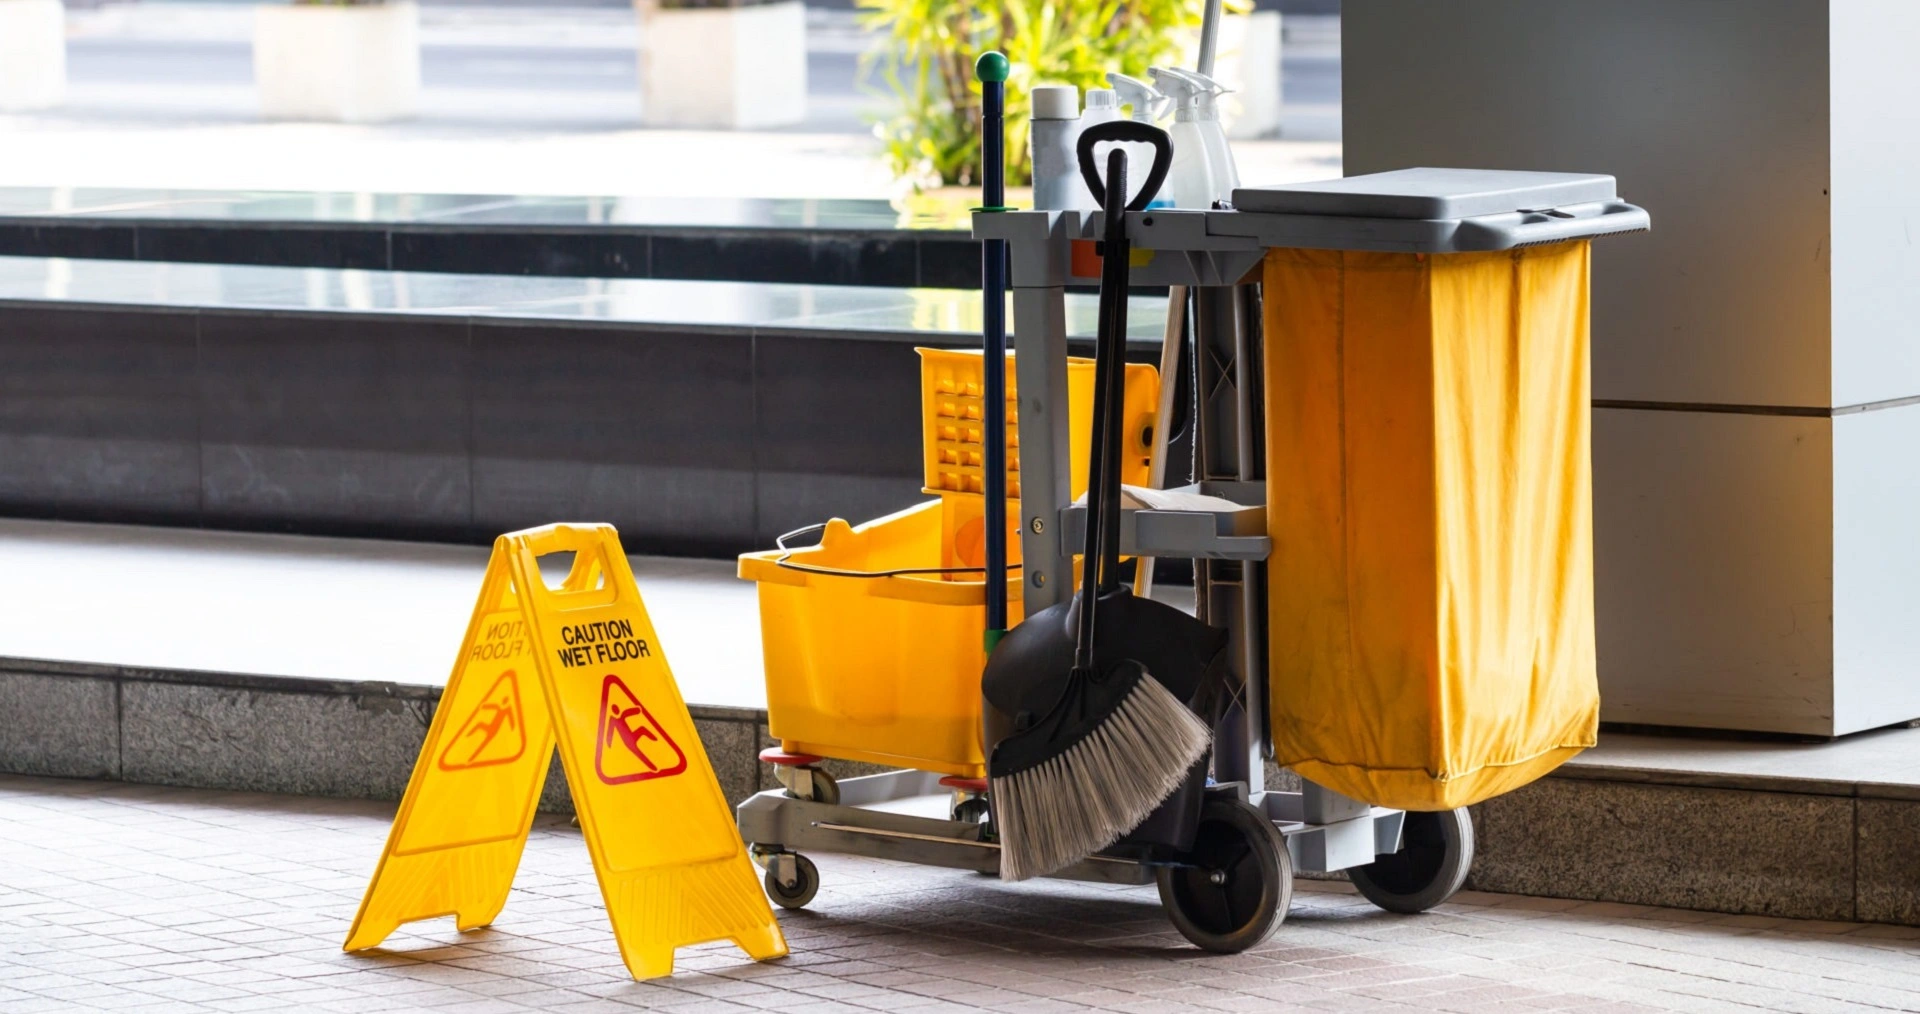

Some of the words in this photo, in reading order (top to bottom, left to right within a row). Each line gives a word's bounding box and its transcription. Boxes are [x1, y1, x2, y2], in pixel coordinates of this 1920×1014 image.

[561, 619, 634, 646] CAUTION
[557, 645, 593, 668] WET
[595, 639, 651, 664] FLOOR
